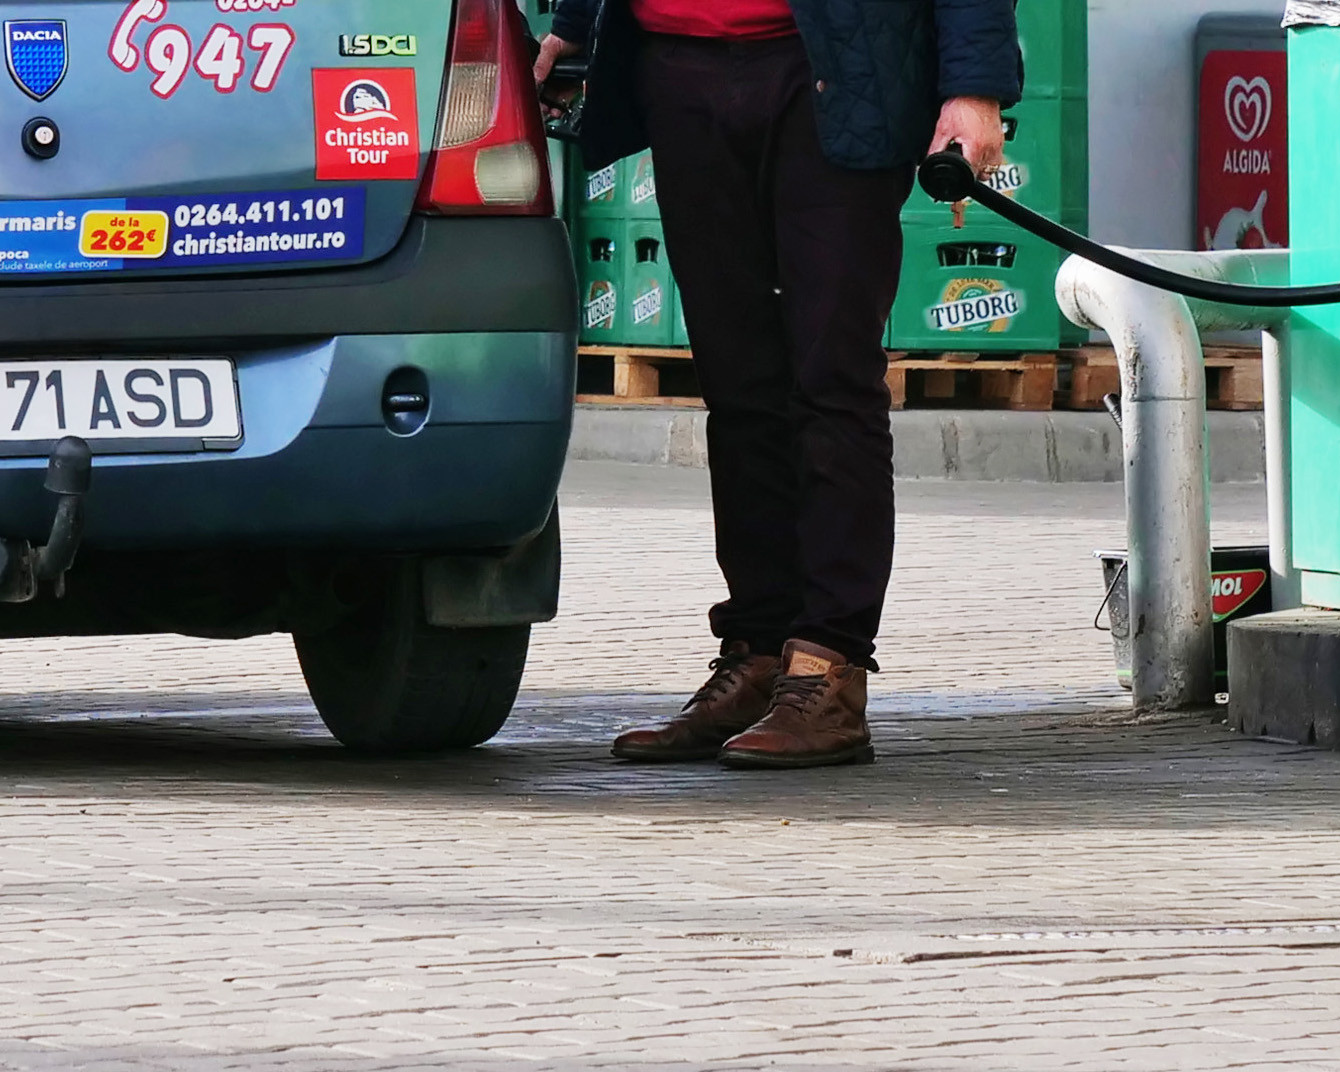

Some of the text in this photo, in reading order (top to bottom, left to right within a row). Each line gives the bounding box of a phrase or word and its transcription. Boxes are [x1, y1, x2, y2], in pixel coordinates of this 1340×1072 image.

[12, 30, 61, 41] DACIA
[146, 23, 296, 99] 947
[324, 128, 409, 147] Christian
[346, 147, 390, 165] Tour
[1223, 149, 1271, 175] ALGIDA
[0, 210, 77, 231] rmaris
[110, 216, 140, 227] de la
[174, 196, 345, 228] 0264.411.101
[90, 229, 156, 251] 262€
[173, 230, 346, 256] christiantour.ro
[24, 260, 53, 270] taxele
[54, 259, 67, 269] de
[68, 259, 108, 271] aeroport
[931, 292, 1019, 328] TUBORG
[5, 368, 214, 431] 71 ASD
[1211, 577, 1243, 597] MOL
